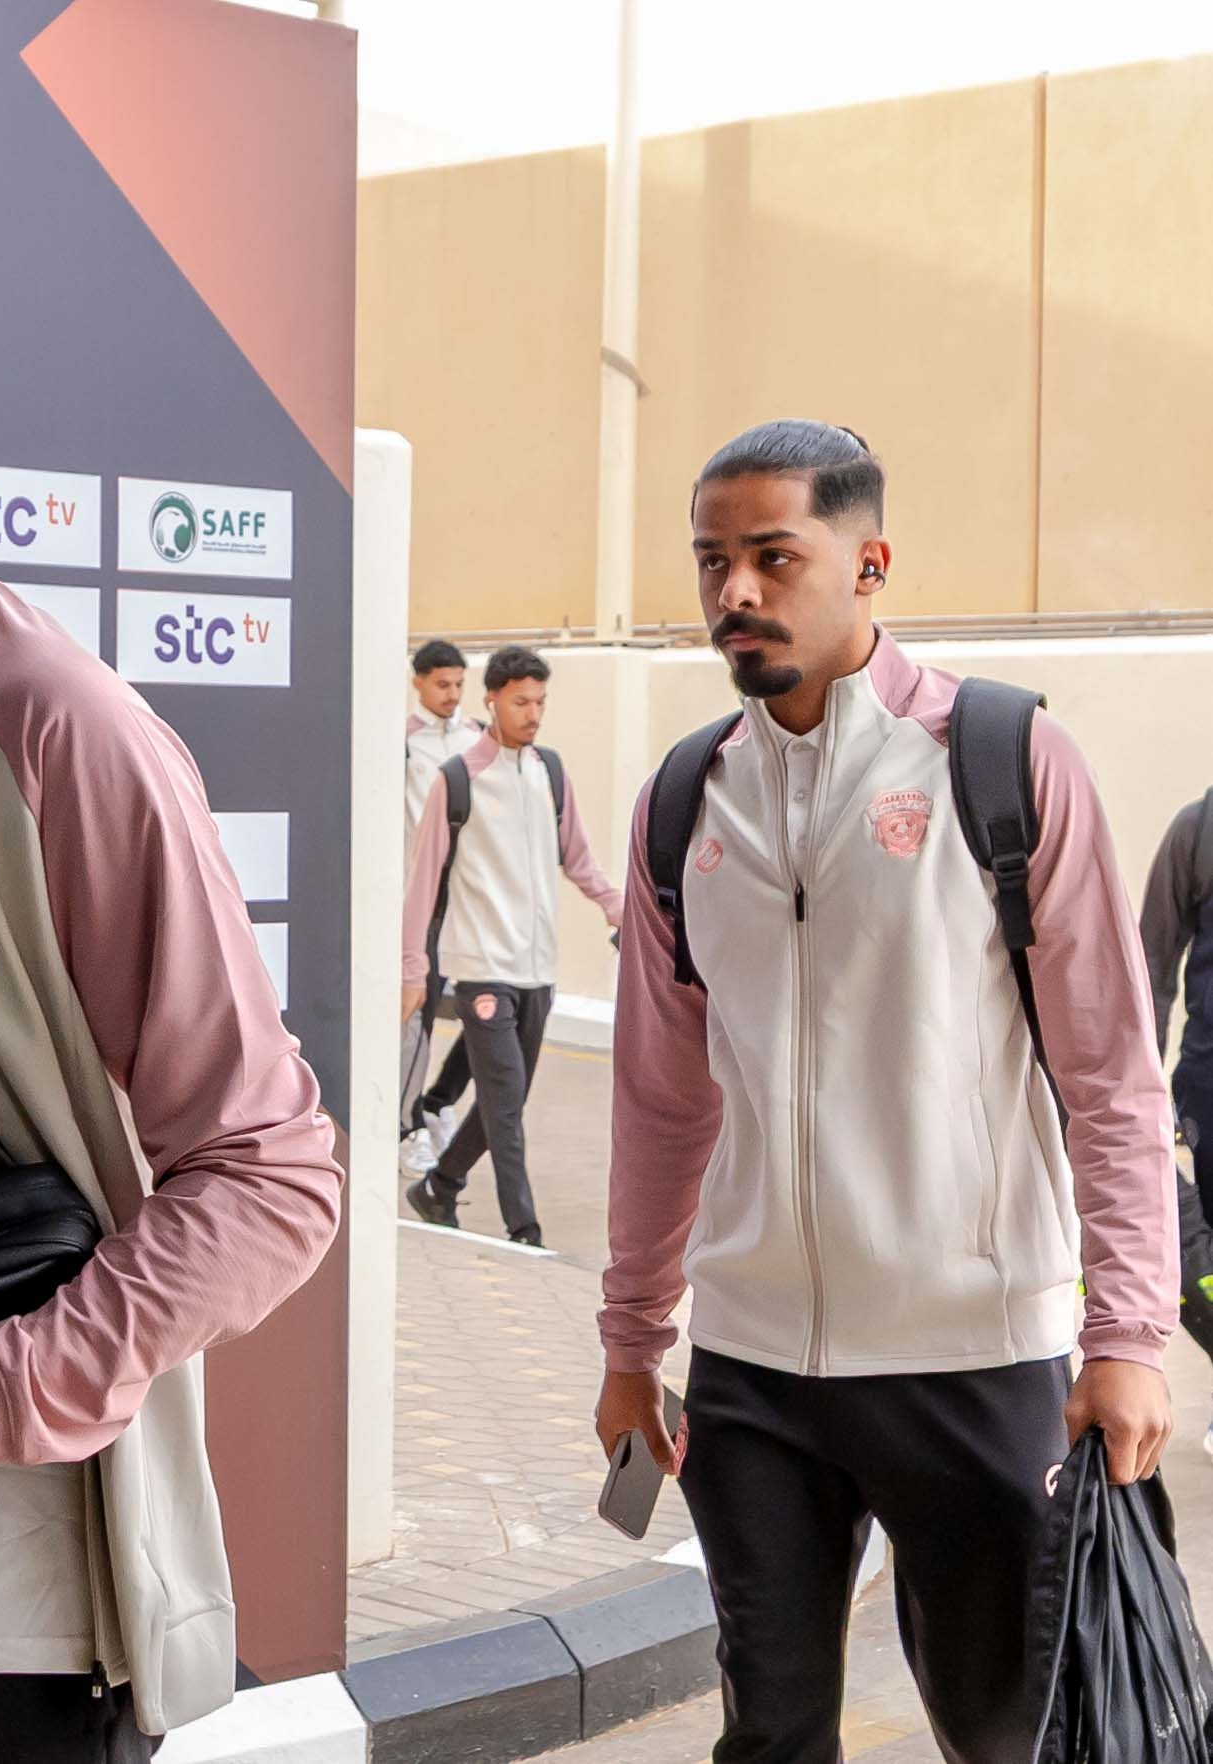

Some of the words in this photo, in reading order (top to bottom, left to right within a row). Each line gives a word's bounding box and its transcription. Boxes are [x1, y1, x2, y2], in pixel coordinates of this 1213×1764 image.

[46, 494, 75, 525] tv
[202, 509, 266, 538] SAFF
[154, 605, 235, 665] stc
[243, 613, 269, 643] tv
